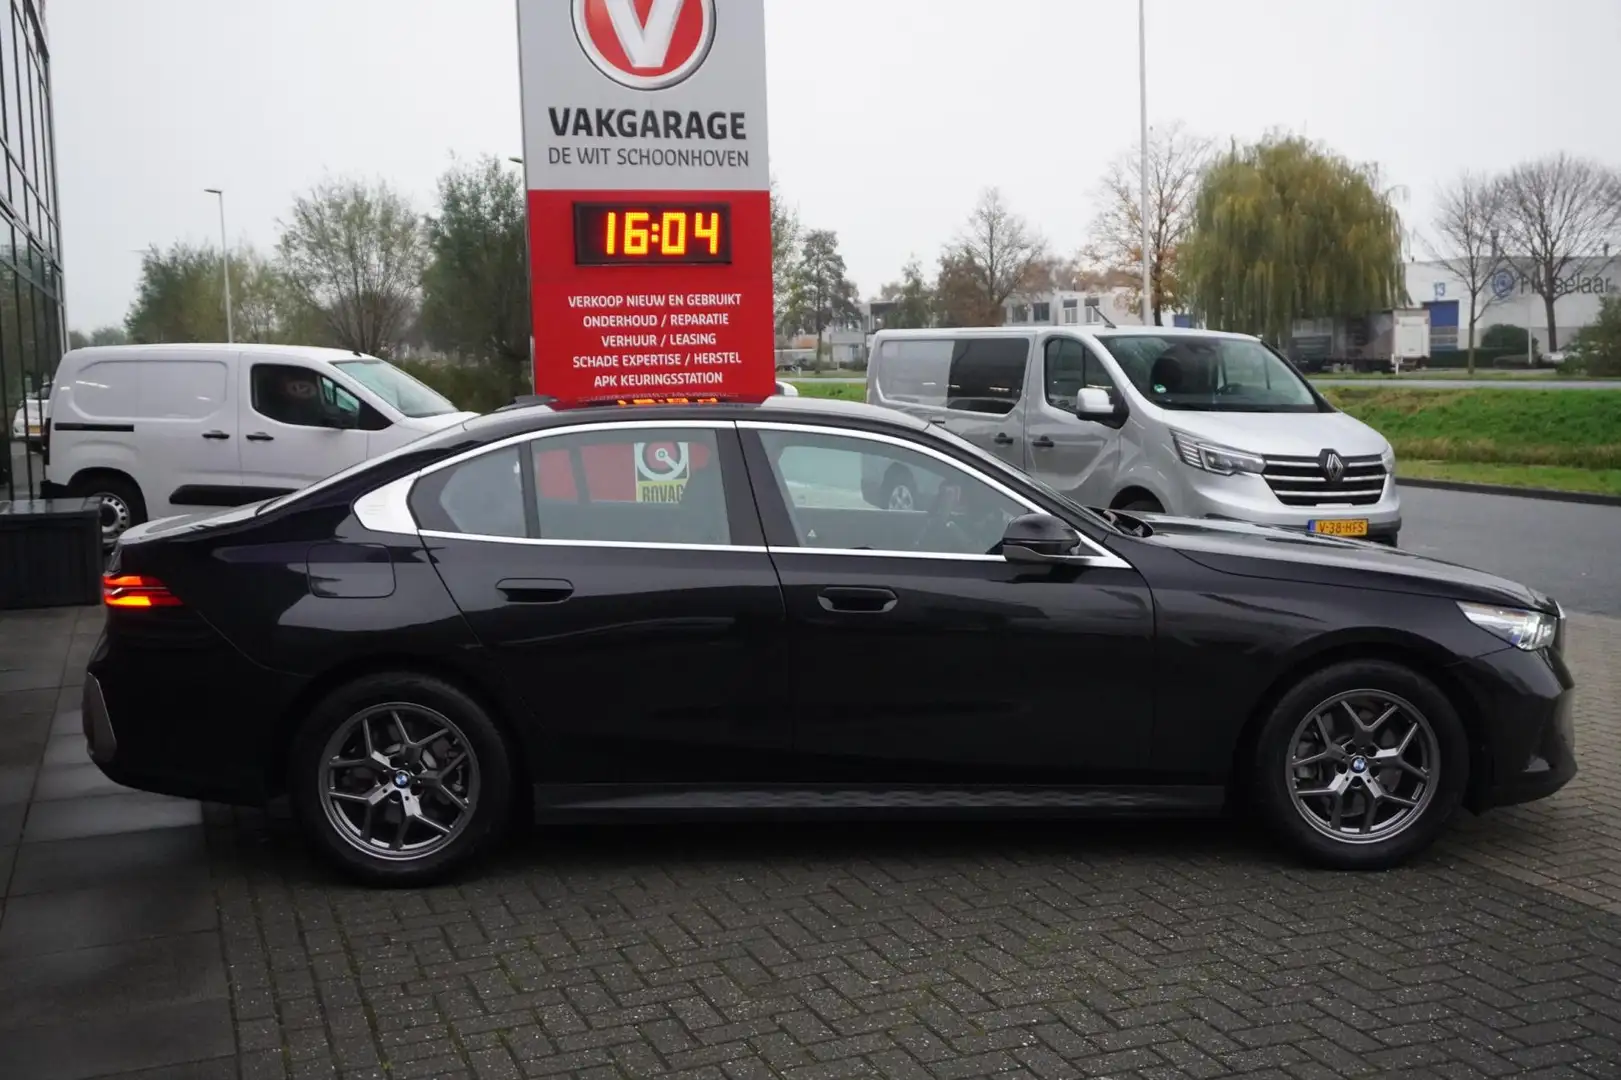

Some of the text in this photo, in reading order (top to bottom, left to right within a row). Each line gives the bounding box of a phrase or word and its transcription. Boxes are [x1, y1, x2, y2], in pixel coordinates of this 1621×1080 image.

[548, 106, 747, 140] VAKGARAGE
[549, 147, 749, 167] DE WIT SCHOONHOVEN
[606, 212, 719, 255] 16:04
[1433, 282, 1446, 296] 13
[568, 293, 742, 308] VERKOOP NIEUW EN GEBRUIKT
[583, 313, 729, 327] ONDERHOUD / REPARATIE
[601, 333, 717, 347] VERHUUR / LEASING
[573, 352, 742, 368] SCHADE EXPERTISE / HERSTEL
[594, 372, 723, 387] APK KEURINGSSTATION
